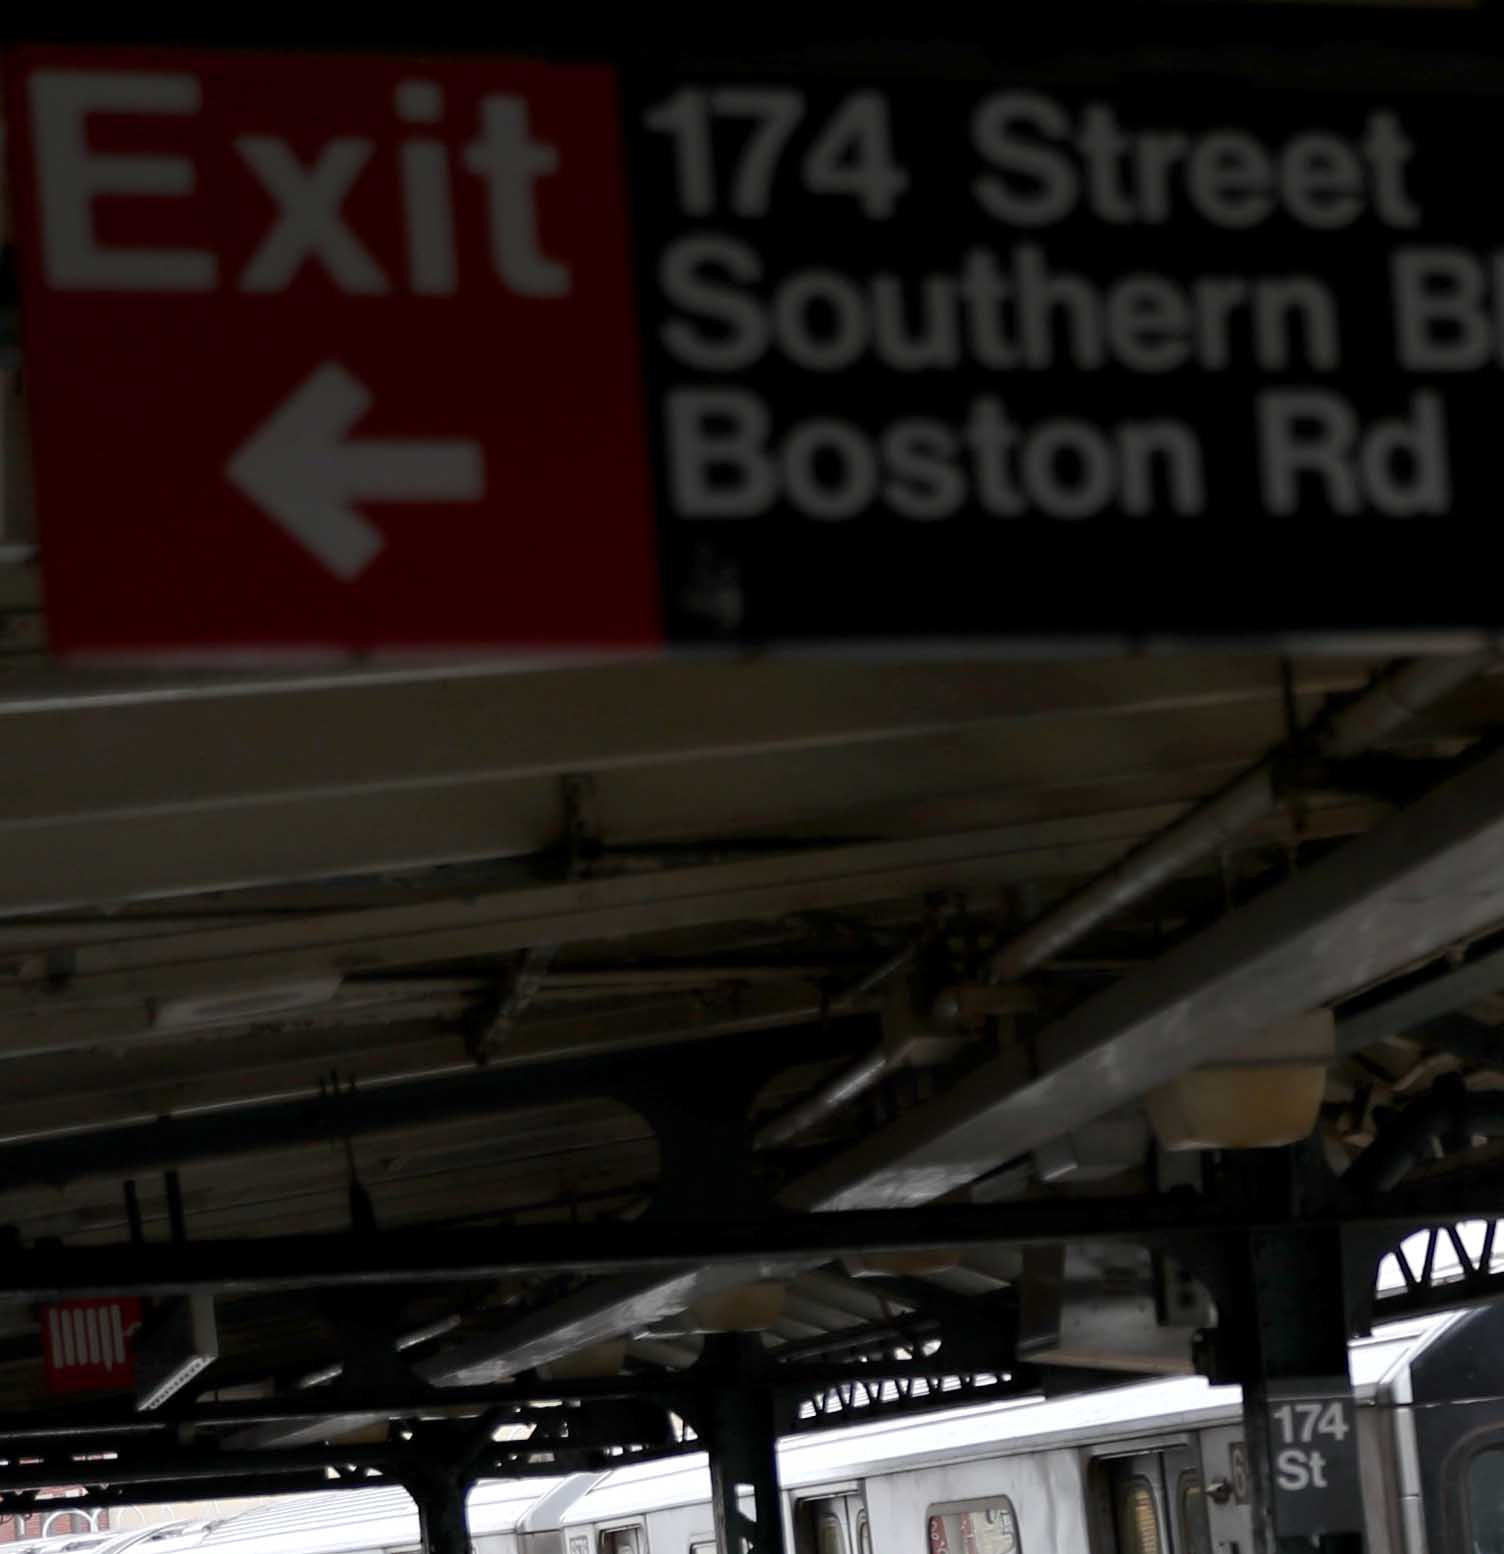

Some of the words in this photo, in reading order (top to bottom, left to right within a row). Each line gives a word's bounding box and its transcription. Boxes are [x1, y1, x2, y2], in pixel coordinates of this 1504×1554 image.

[25, 66, 573, 299] Exit
[643, 84, 911, 221] 174
[968, 90, 1423, 230] Street
[655, 232, 1340, 374] Southern
[661, 383, 1208, 522] Boston
[1256, 388, 1453, 519] Rd
[1273, 1400, 1350, 1443] 174
[1278, 1450, 1328, 1491] St
